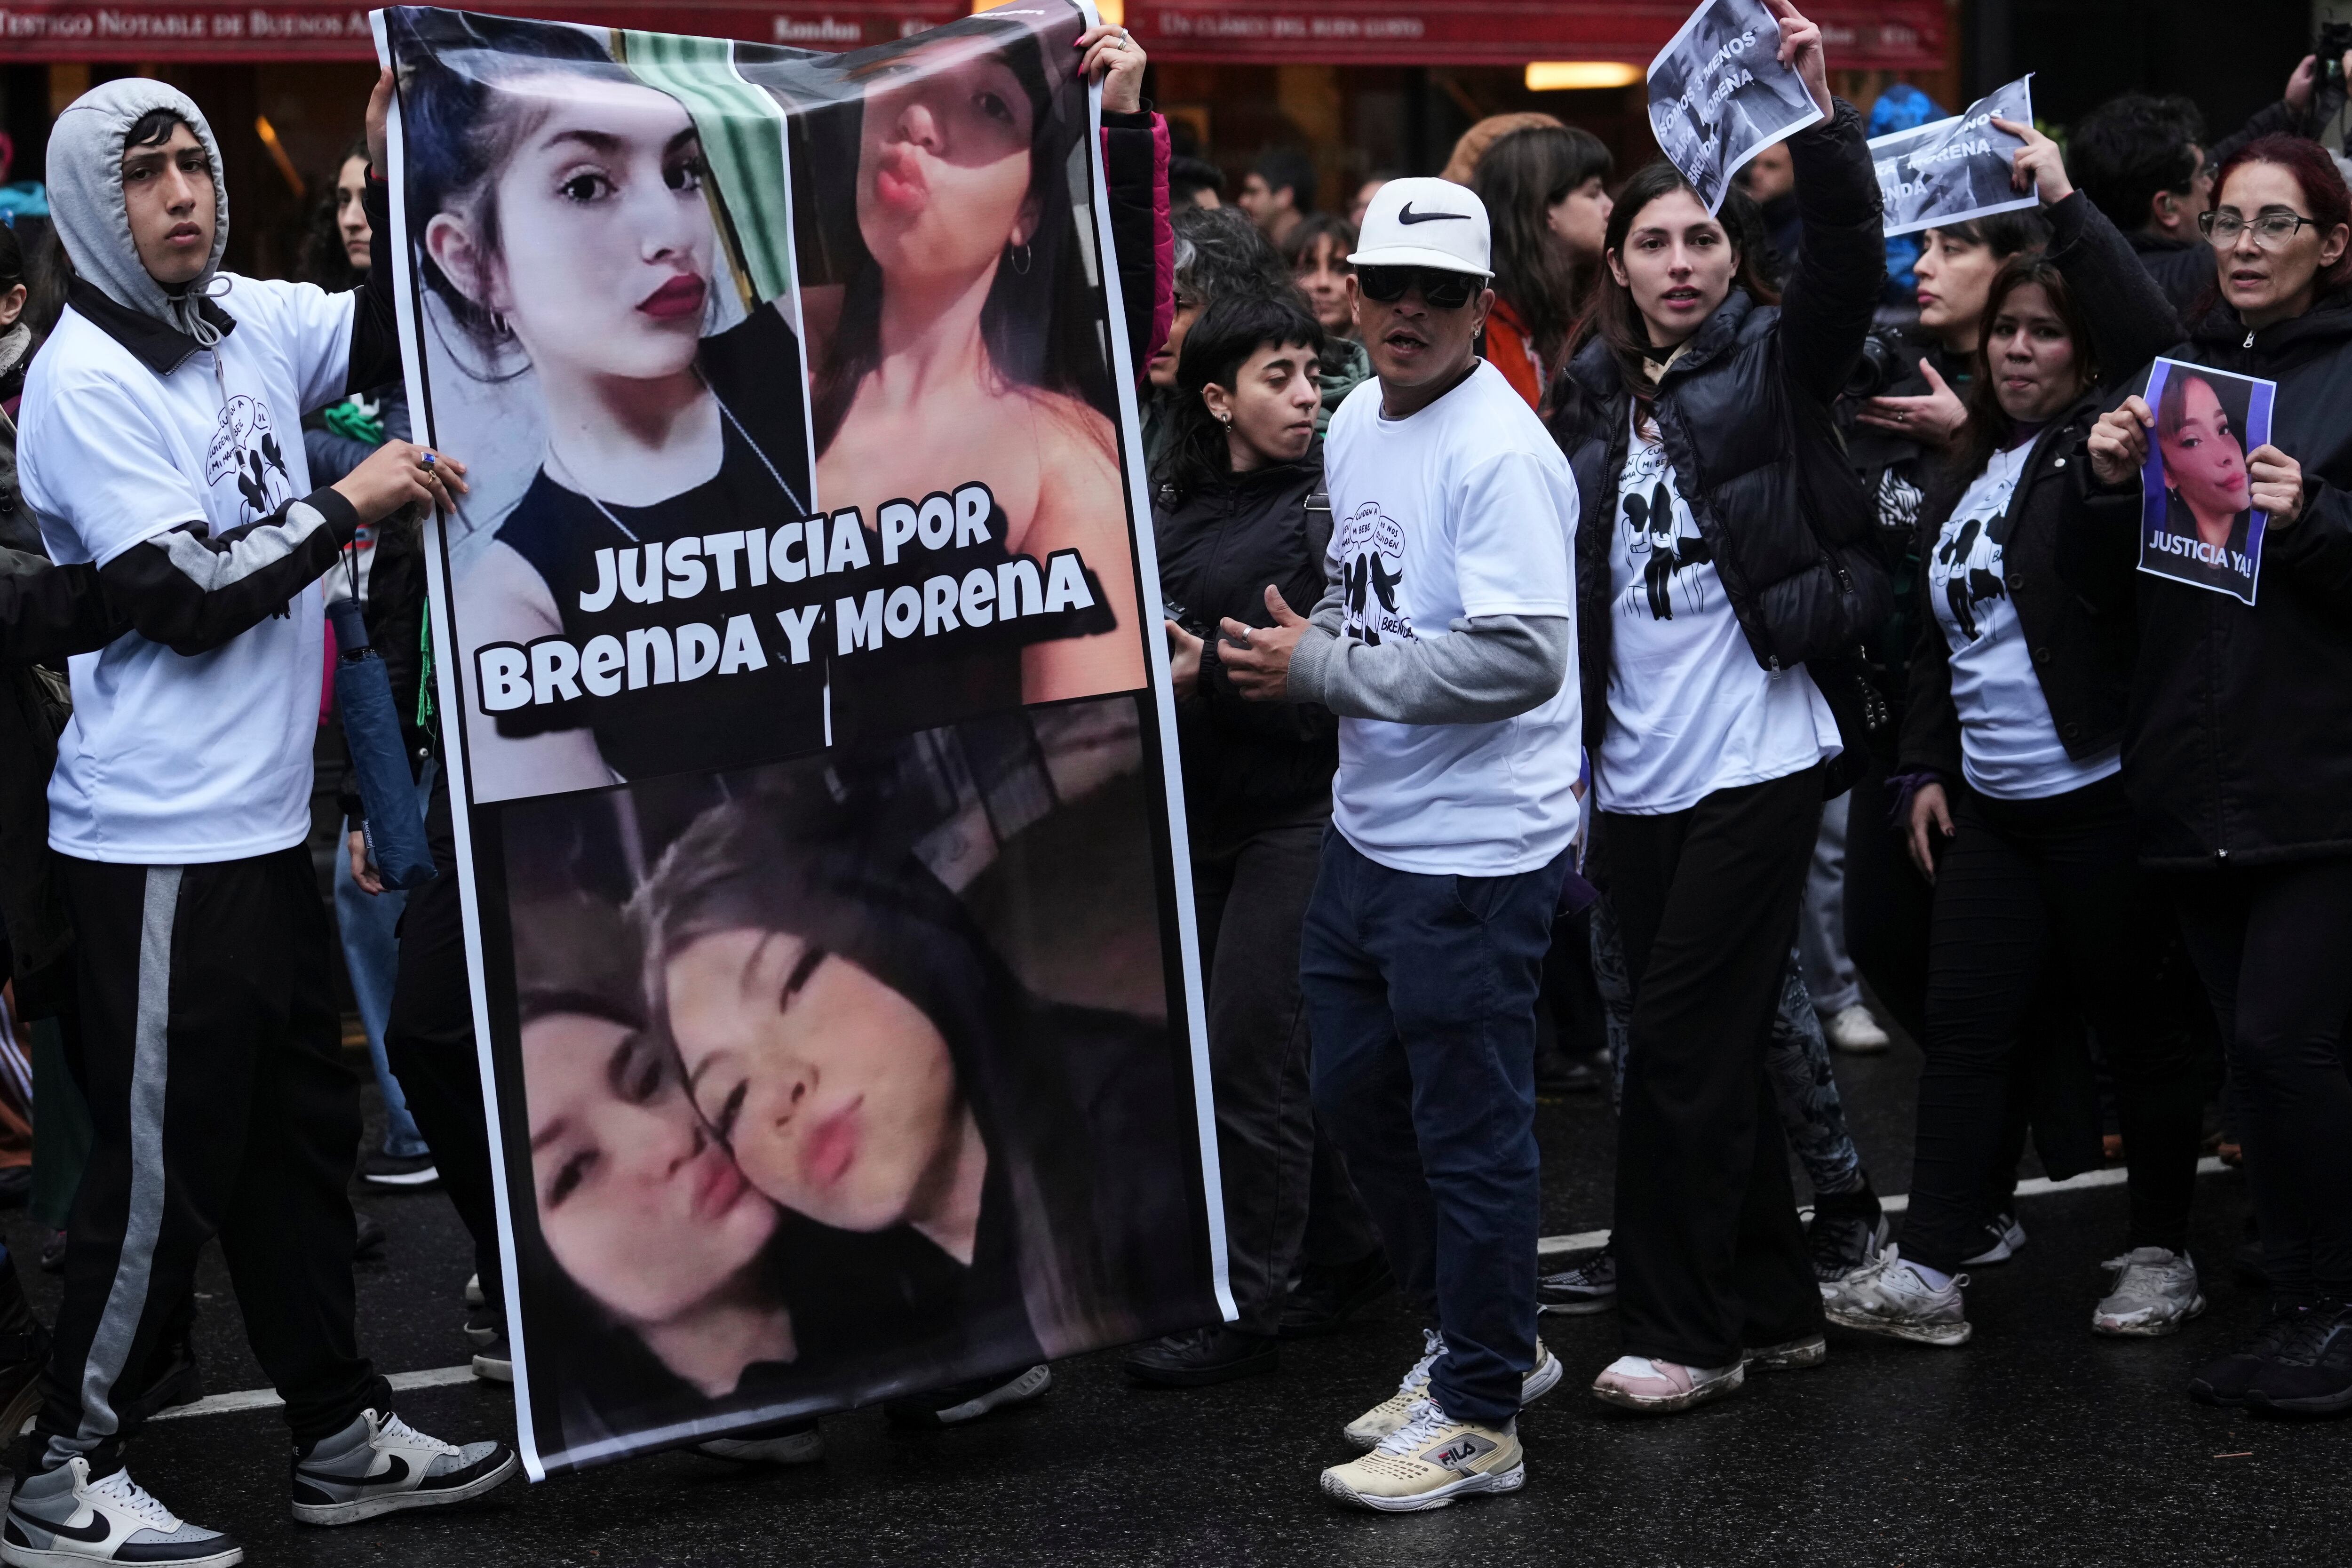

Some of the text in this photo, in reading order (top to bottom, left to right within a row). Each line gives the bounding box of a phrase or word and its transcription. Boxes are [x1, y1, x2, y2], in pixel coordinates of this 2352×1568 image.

[1659, 31, 1756, 137] SOMOS 3 MENOS
[1670, 68, 1754, 164] LARA MORENA
[1957, 109, 2002, 136] ENOS
[1687, 132, 1719, 187] BRENDA
[1882, 180, 1928, 203] ENDA
[238, 400, 244, 409] A
[1356, 508, 1373, 520] CUIDEN
[1359, 523, 1371, 534] BEBE
[1376, 531, 1399, 549] OLVIDEN
[1387, 525, 1398, 538] NOS
[579, 486, 992, 613] JUSTICIA POR
[2149, 530, 2252, 578] JUSTICIA YA!
[777, 604, 825, 664] Y
[364, 821, 373, 847] BAGCHERRY
[1438, 1441, 1476, 1465] FILA
